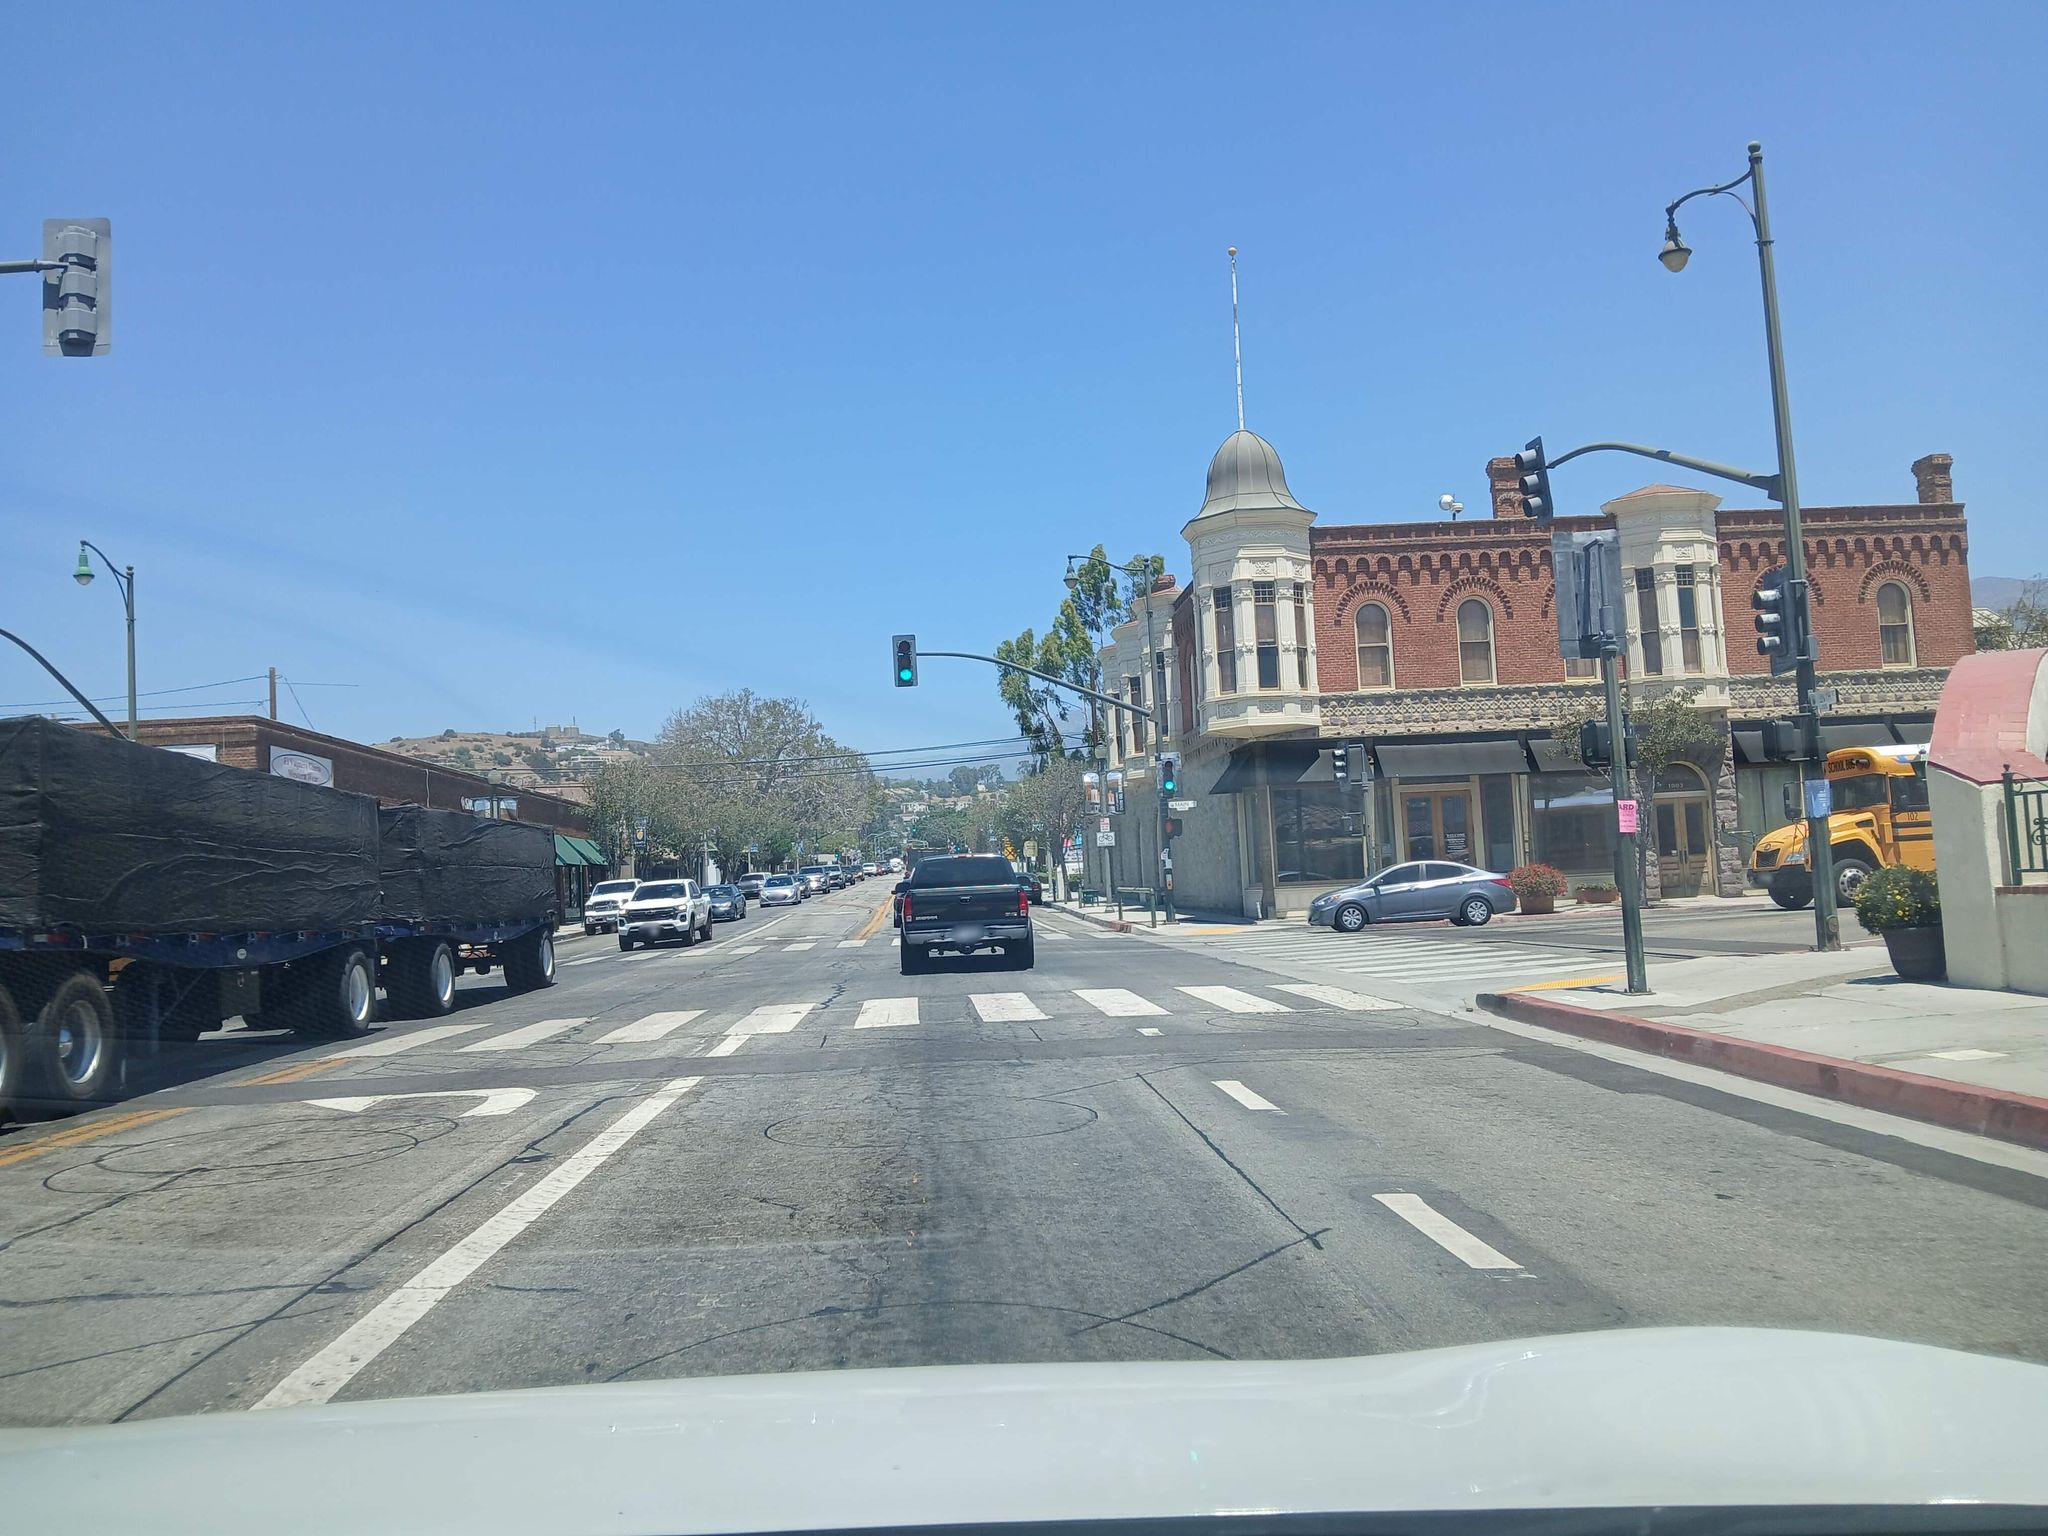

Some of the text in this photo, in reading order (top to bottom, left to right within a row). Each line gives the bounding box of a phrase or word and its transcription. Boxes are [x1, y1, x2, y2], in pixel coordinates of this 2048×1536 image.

[1828, 759, 1856, 773] SCHOOL BUS
[1907, 812, 1919, 820] 102
